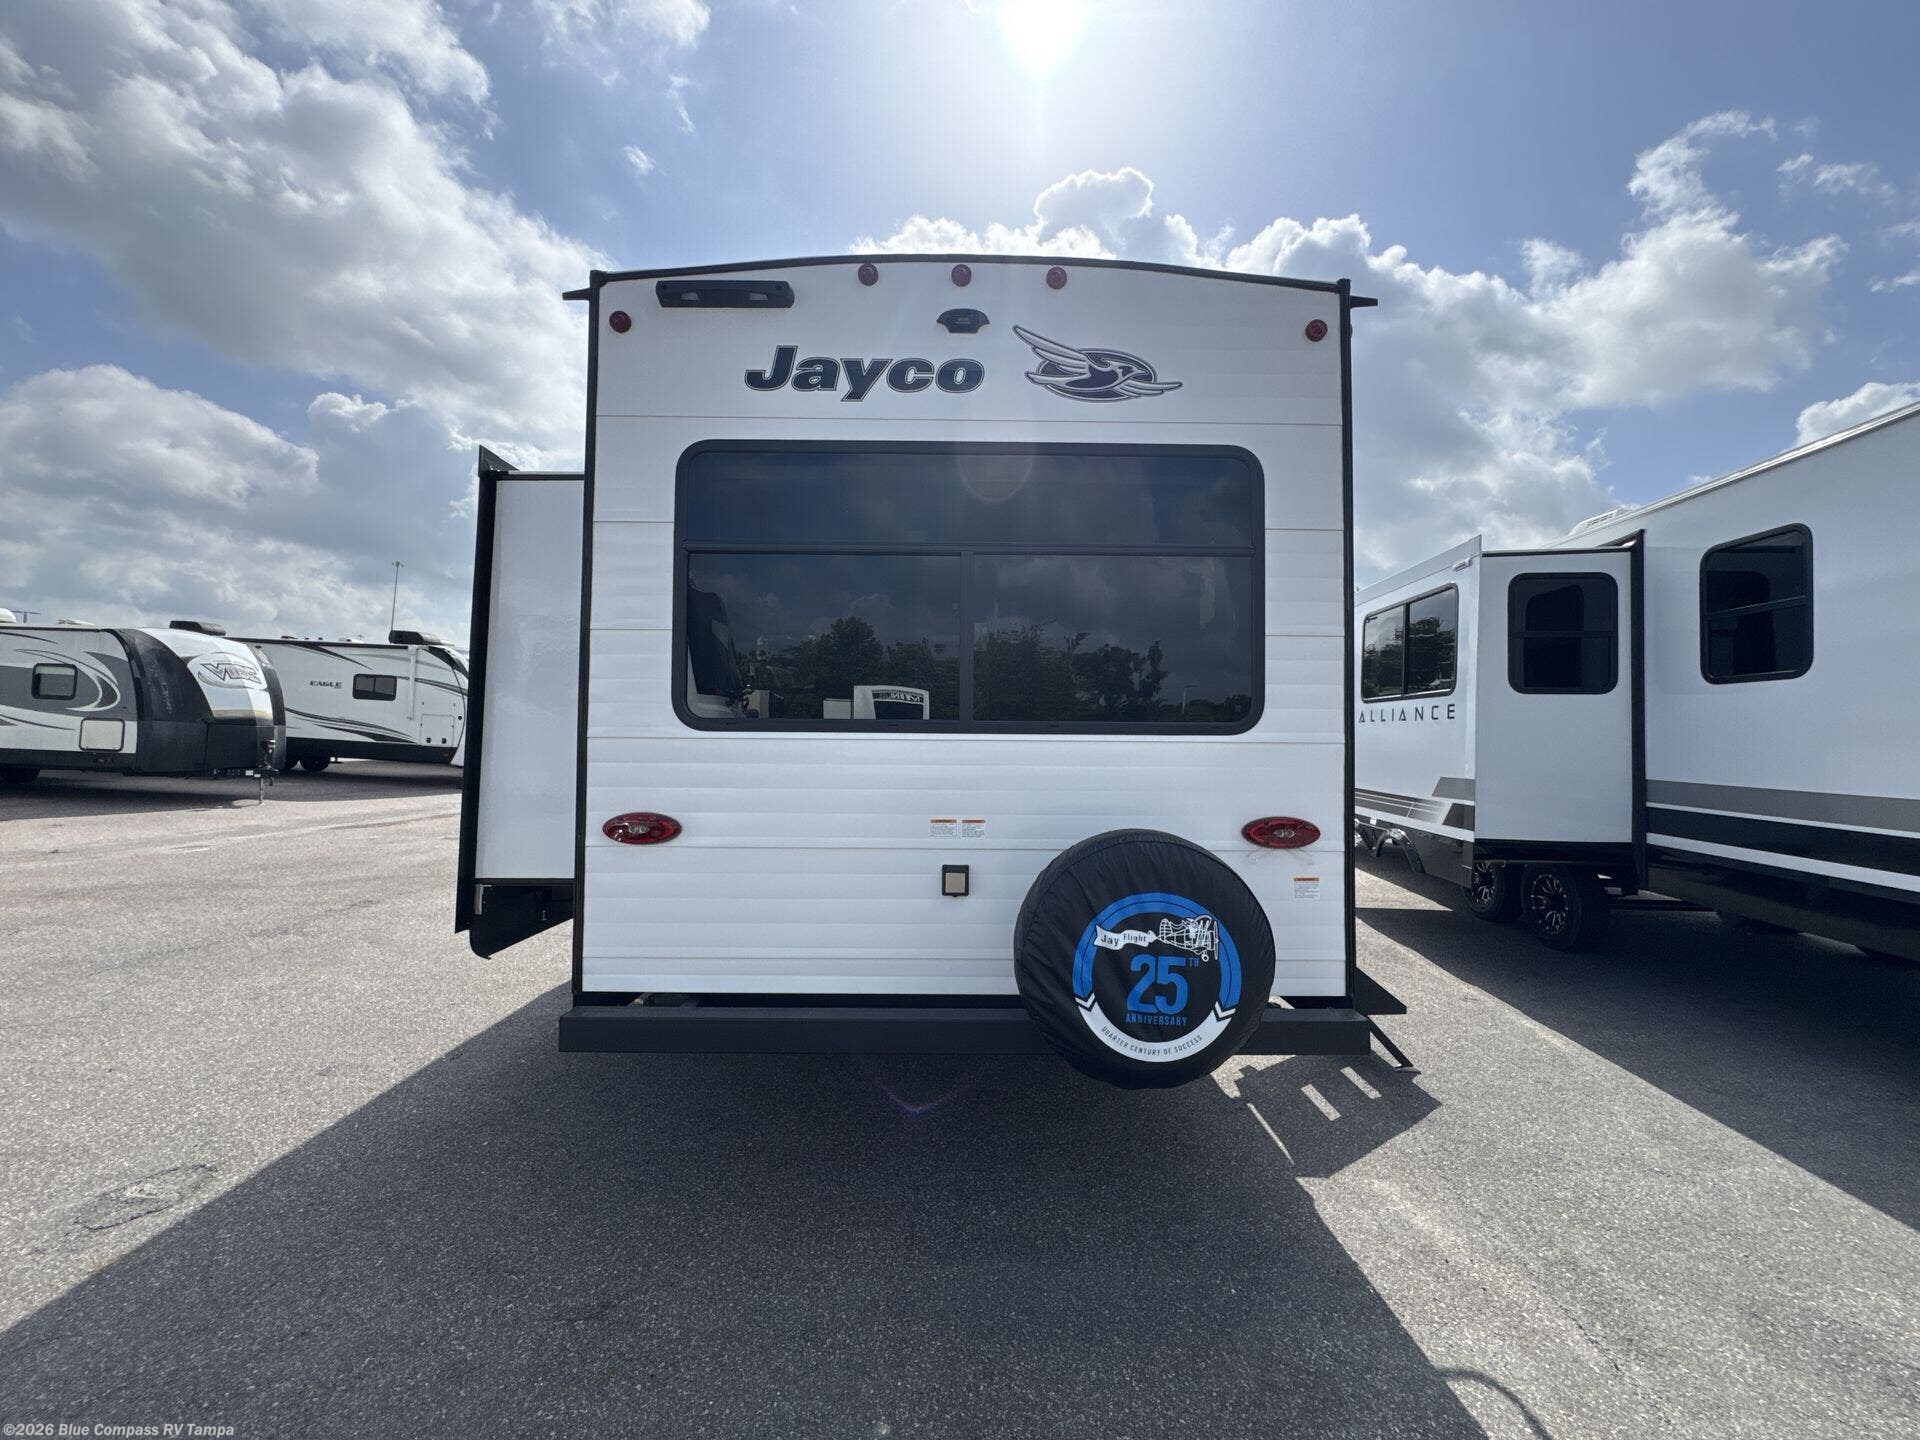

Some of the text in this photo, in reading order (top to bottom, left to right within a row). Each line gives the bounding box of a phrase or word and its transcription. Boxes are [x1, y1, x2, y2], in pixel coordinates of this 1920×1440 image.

[743, 345, 985, 403] Jayco
[310, 680, 343, 688] EAGLE
[1358, 704, 1455, 723] ALLIANCE
[1101, 933, 1147, 947] Jay Flight
[1125, 1013, 1188, 1026] ANNIVERSARY
[1101, 1026, 1203, 1056] QUARTER CENTURY OF SUCCESS
